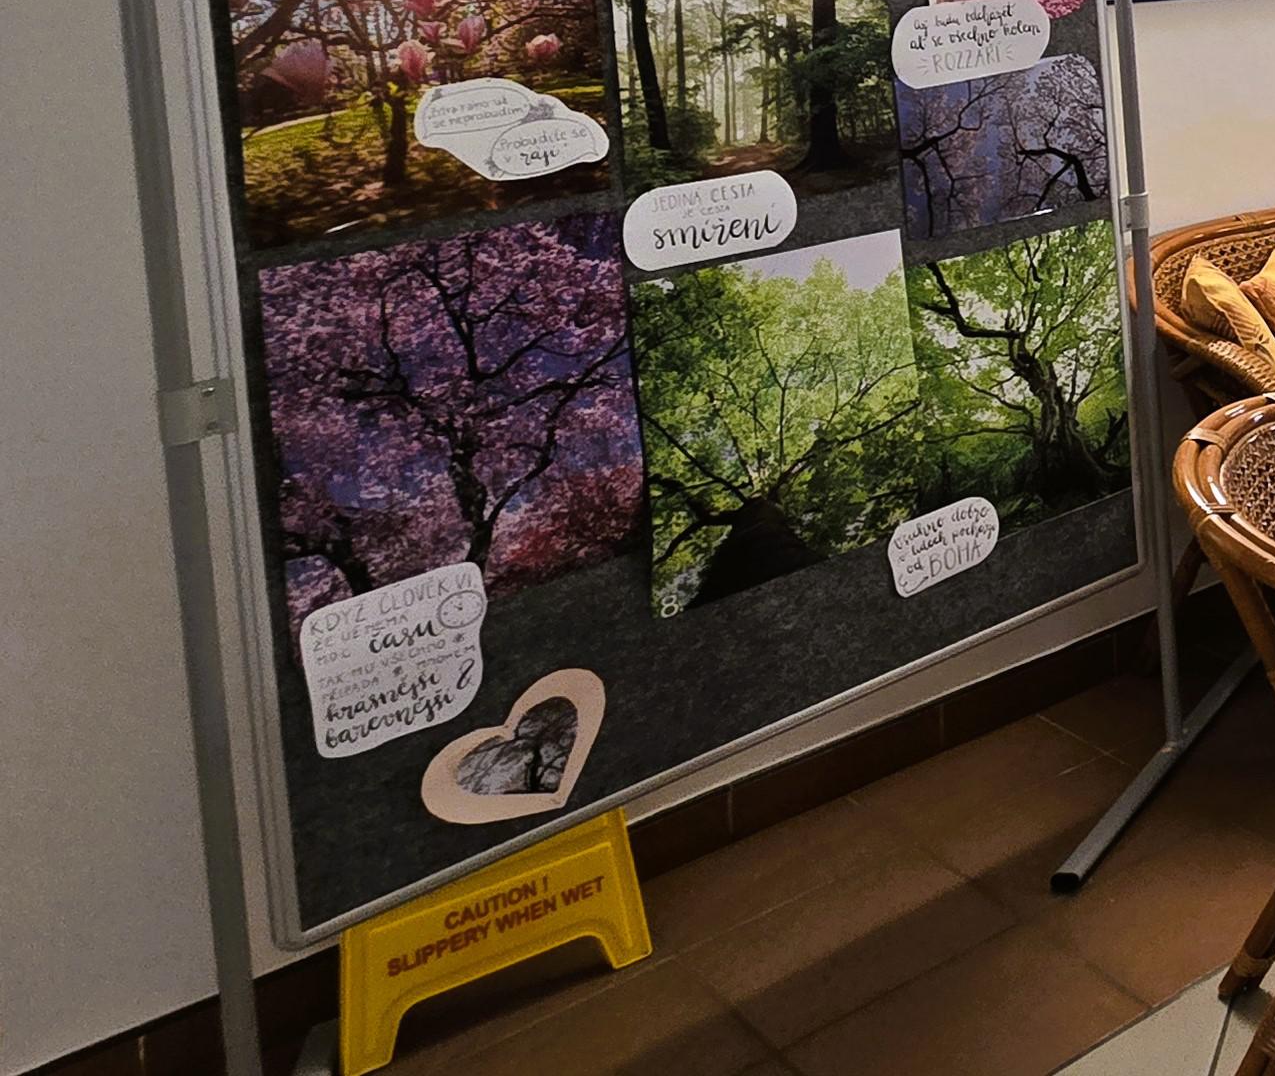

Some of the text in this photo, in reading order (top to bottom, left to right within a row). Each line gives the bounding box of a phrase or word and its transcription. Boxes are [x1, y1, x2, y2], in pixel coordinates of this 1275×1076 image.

[651, 182, 756, 213] JEDINÁ CESTA
[653, 202, 783, 250] smíření
[906, 538, 982, 579] od BOHA
[309, 598, 367, 637] KDYŽ
[379, 576, 451, 616] ČLOVĚK
[368, 620, 443, 654] času
[387, 875, 606, 977] SLIPPERY WHEN WET
[443, 875, 549, 931] CAUTION !
